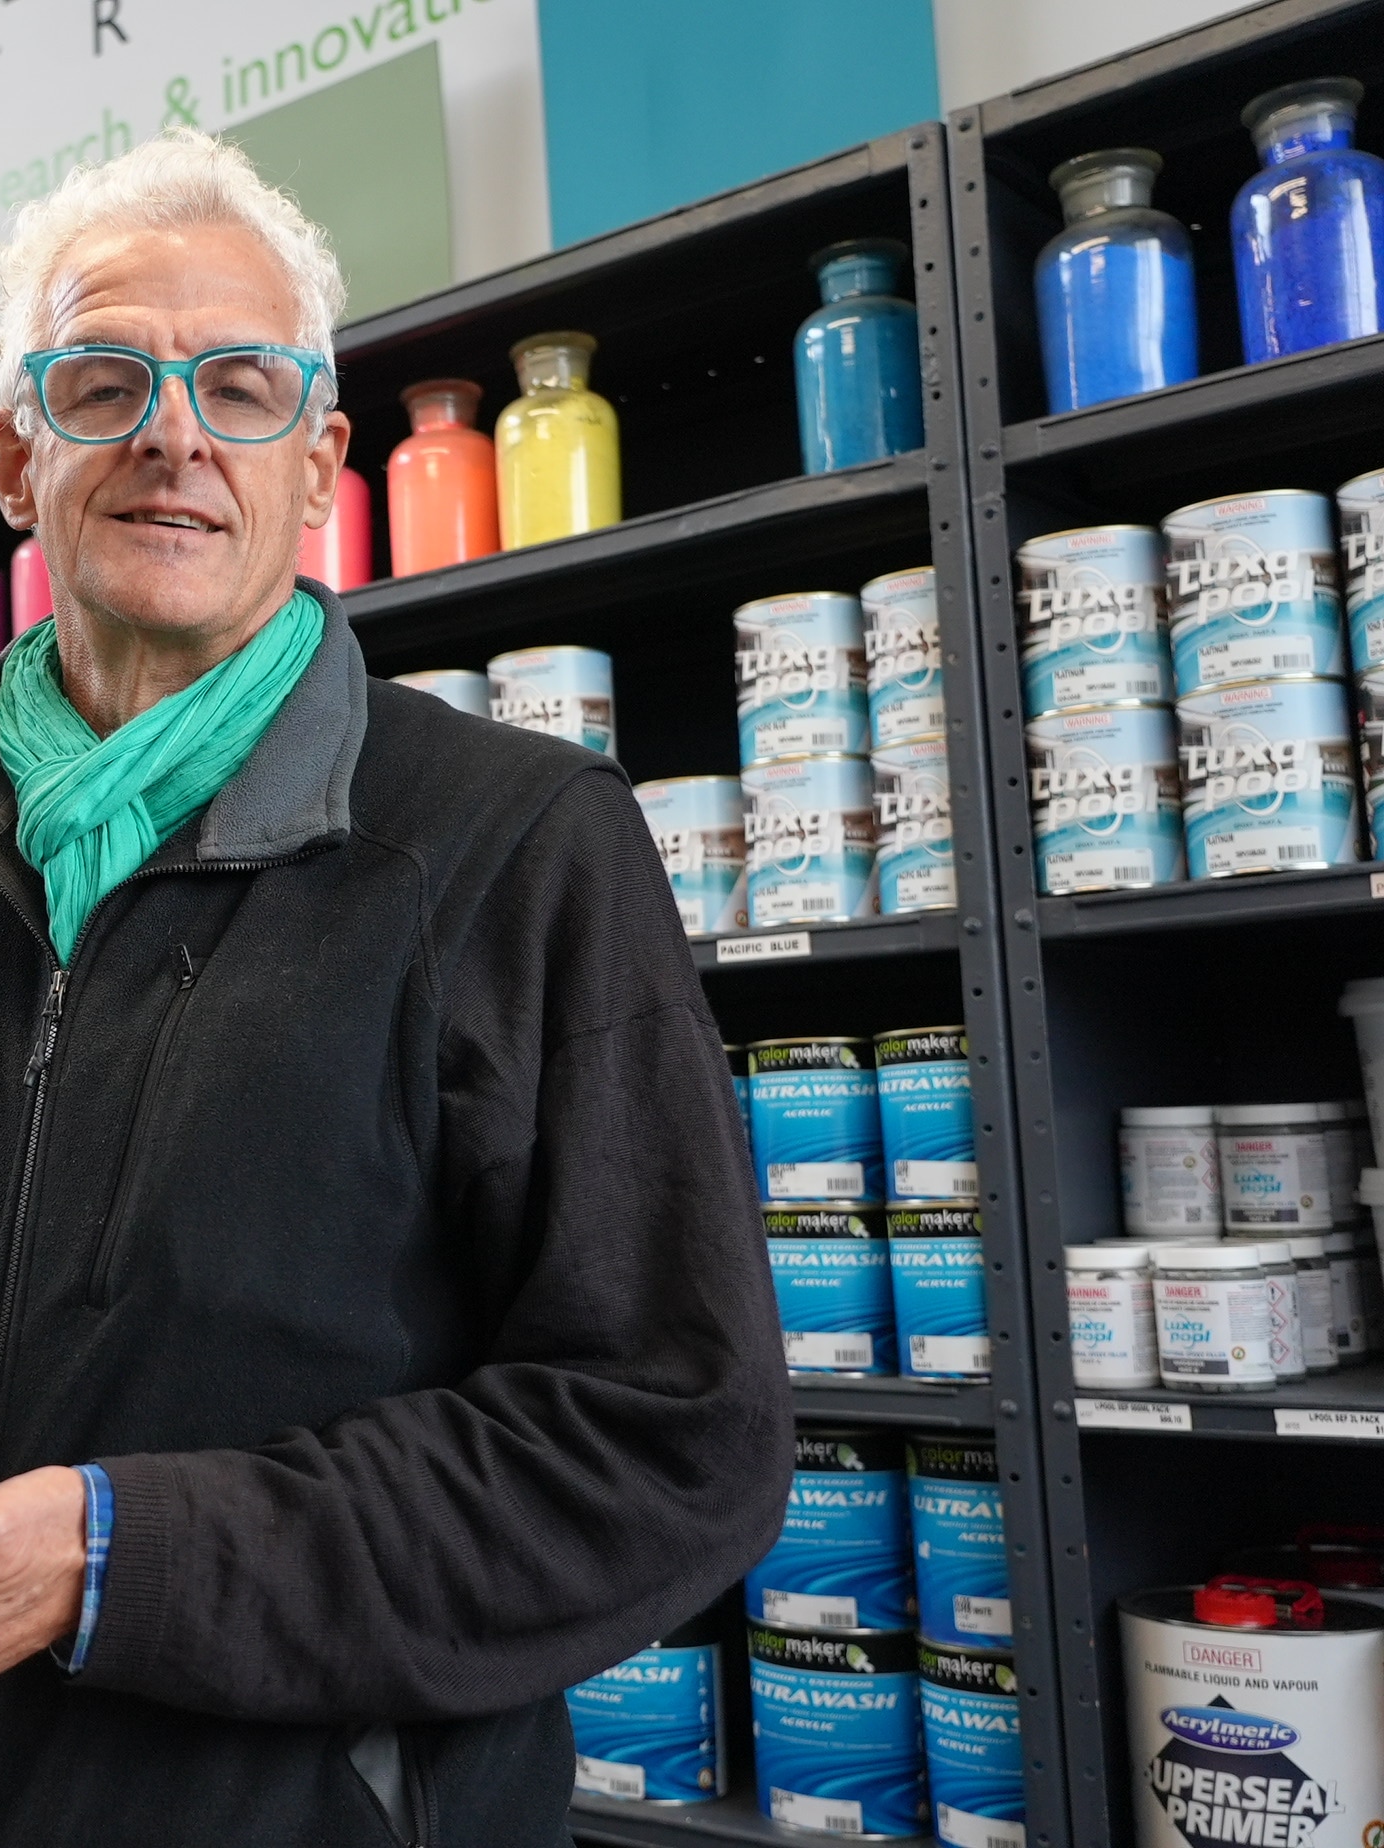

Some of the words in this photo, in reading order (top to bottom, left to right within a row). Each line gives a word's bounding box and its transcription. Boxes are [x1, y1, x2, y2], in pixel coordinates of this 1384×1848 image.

[1197, 569, 1315, 625] pool
[1049, 599, 1157, 650] pool
[754, 661, 849, 708] pool
[1204, 758, 1323, 811] pool
[1047, 783, 1159, 831] pool
[752, 826, 844, 872] pool
[720, 942, 763, 955] PACIFIC
[770, 939, 800, 952] BLUE
[757, 1043, 839, 1062] colormaker
[879, 1033, 958, 1055] colormaker
[1165, 1286, 1201, 1298] DANGER
[1190, 1646, 1254, 1668] DANGER
[1144, 1659, 1200, 1682] FLAMMABLE
[1203, 1672, 1241, 1688] LIQUID
[1244, 1678, 1269, 1690] AND
[1273, 1679, 1319, 1692] VAPOUR
[780, 1715, 836, 1732] ACRYLIC
[1164, 1709, 1292, 1741] Acrylmeric
[937, 1737, 988, 1756] ACRYLIC
[1211, 1733, 1270, 1749] SYSTEM
[1166, 1794, 1317, 1848] PRIMER
